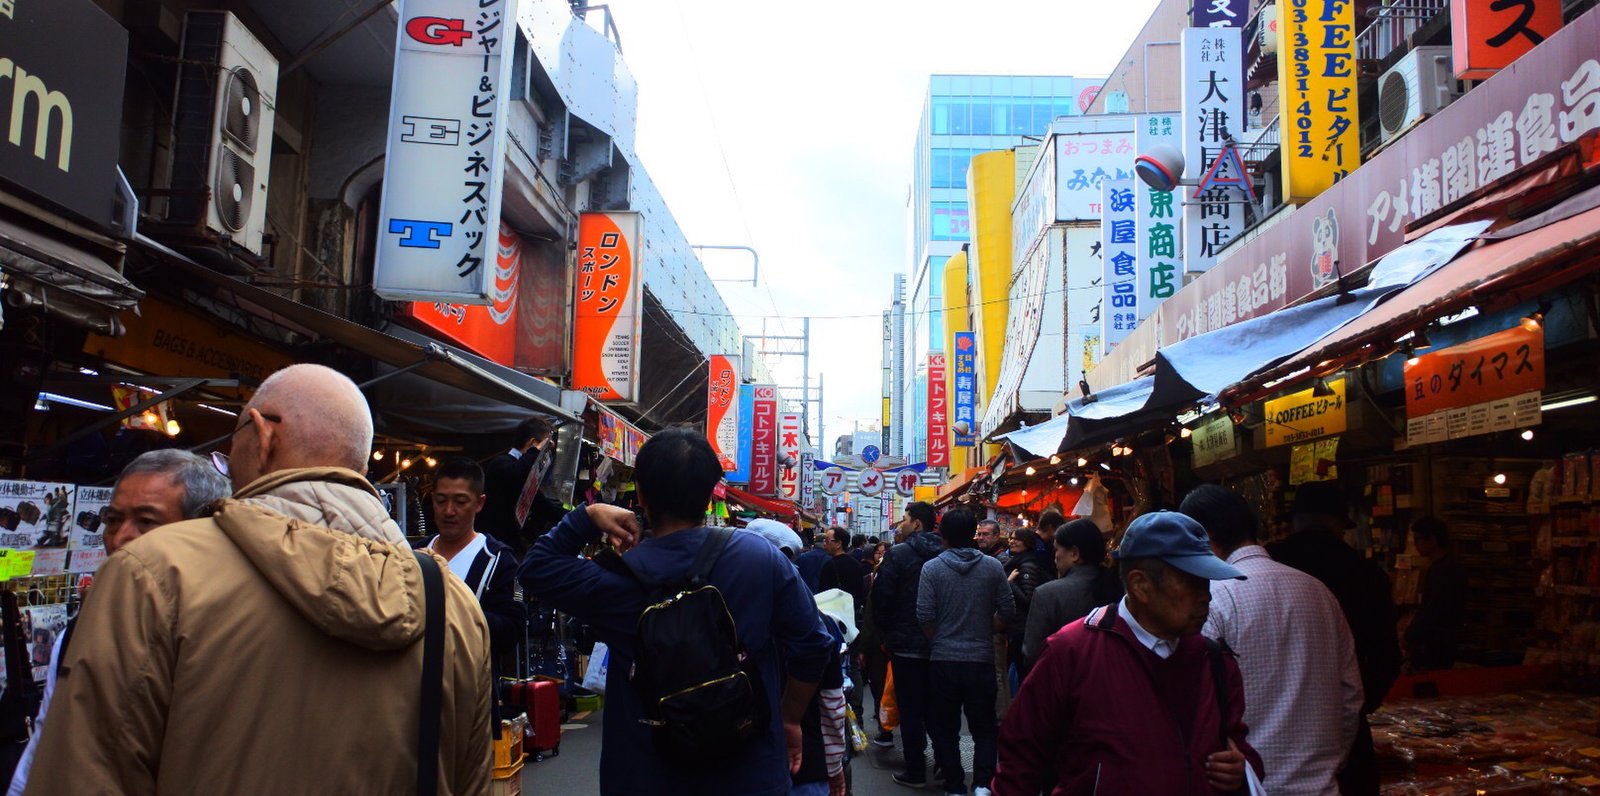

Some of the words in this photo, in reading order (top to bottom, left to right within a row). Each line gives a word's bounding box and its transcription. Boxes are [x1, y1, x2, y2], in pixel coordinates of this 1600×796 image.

[1064, 138, 1133, 156] おつまみ
[1110, 187, 1137, 308] 浜屋食品
[581, 247, 596, 302] スポーツ
[597, 232, 621, 313] ロンドン
[152, 329, 186, 356] BAGS
[719, 369, 731, 407] ロンドン
[1414, 343, 1534, 401] 豆のダイマス
[1276, 402, 1314, 425] COFFEE
[802, 461, 813, 507] マルセル
